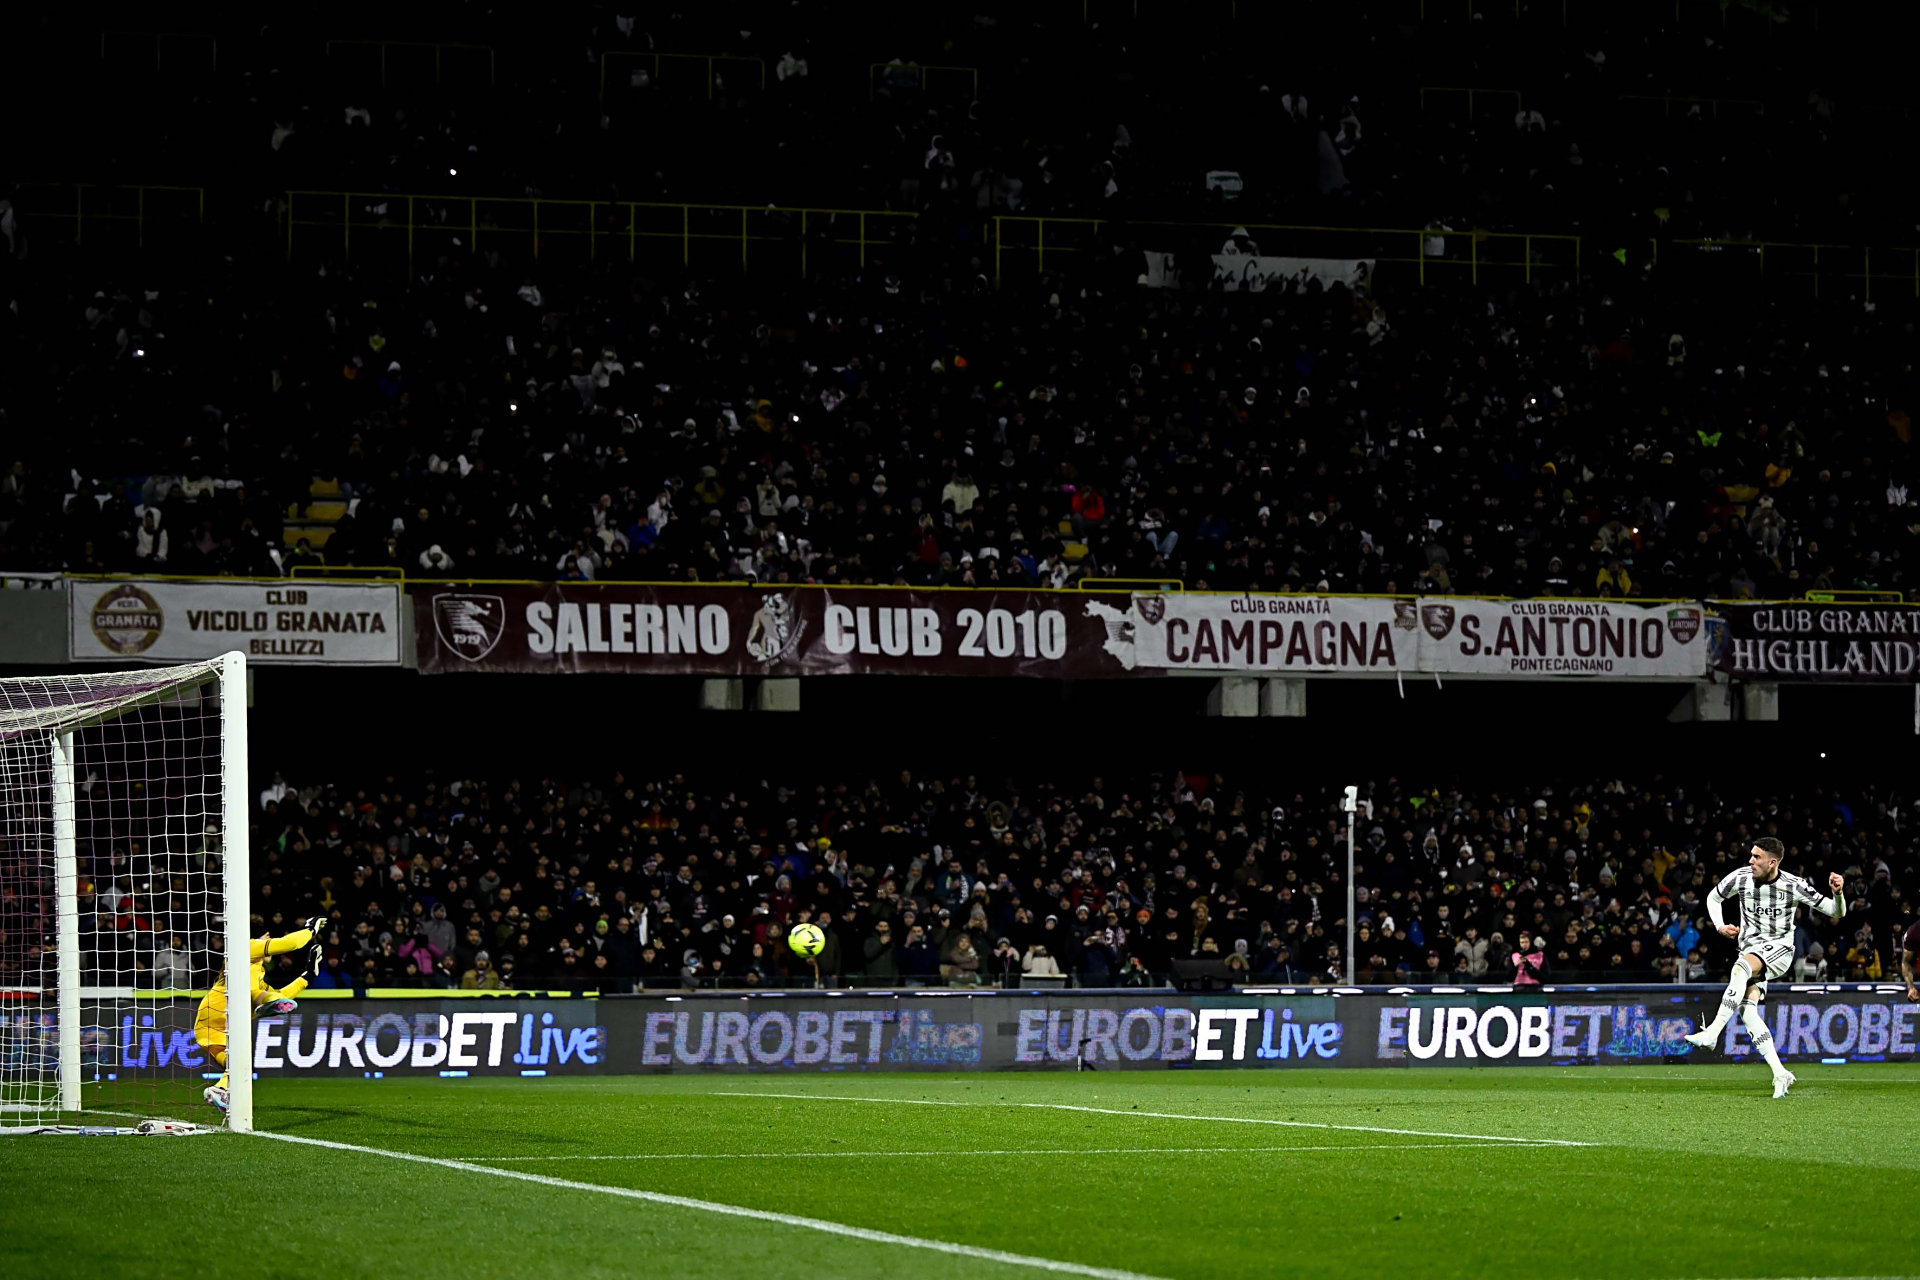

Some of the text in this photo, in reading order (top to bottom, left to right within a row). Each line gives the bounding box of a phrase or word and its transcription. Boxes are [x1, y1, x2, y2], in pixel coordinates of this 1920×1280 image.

[266, 591, 308, 605] CLUB
[1231, 599, 1331, 615] CLUB GRANATA
[1512, 603, 1610, 616] CLUB GRANATA
[96, 615, 158, 627] GRANATA
[187, 610, 386, 633] VICOLO GRANATA
[1752, 609, 1812, 632] CLUB
[525, 601, 731, 655] SALERNO
[824, 604, 942, 657] CLUB
[956, 608, 1067, 660] 2010
[1460, 614, 1664, 659] S.ANTONIO
[250, 639, 324, 655] BELLIZZI
[453, 633, 480, 645] 1919
[1166, 617, 1396, 666] CAMPAGNA
[1732, 638, 1920, 675] HIGHLAND
[1511, 658, 1613, 672] PONTECAGNANO
[1747, 903, 1782, 918] Jeep
[1764, 944, 1774, 952] 9
[1725, 1003, 1920, 1056] EUROBE
